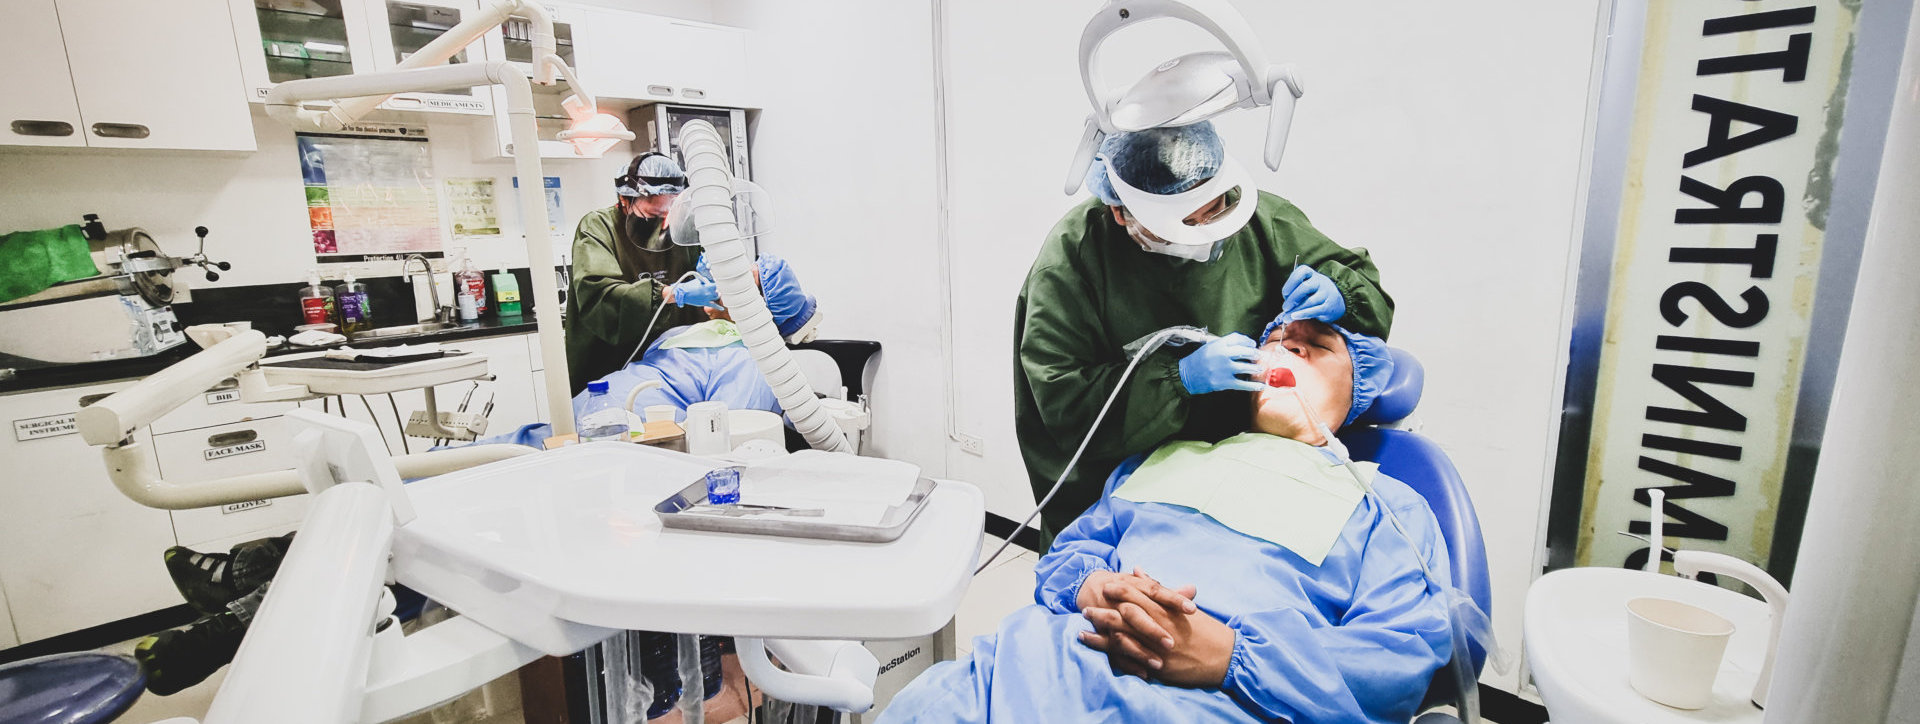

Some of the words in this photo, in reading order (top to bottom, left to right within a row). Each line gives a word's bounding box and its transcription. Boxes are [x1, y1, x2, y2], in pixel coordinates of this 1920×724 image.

[216, 393, 233, 401] BIB
[20, 419, 65, 430] SURGICAL
[29, 424, 76, 436] INSTRUME
[208, 447, 233, 457] FACE
[235, 443, 262, 452] MASK
[228, 499, 267, 512] GLOVES
